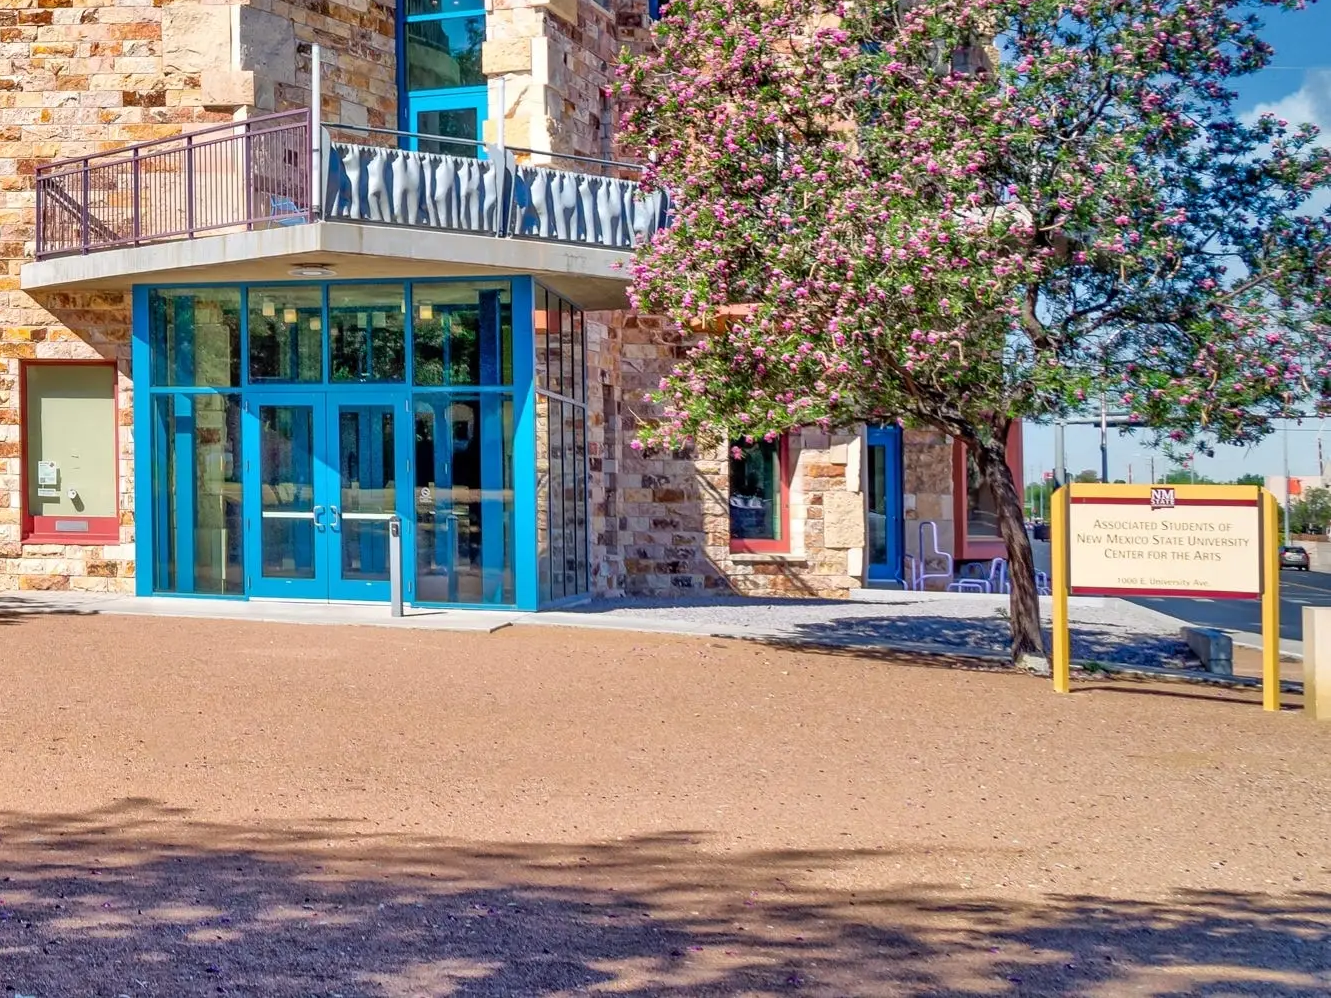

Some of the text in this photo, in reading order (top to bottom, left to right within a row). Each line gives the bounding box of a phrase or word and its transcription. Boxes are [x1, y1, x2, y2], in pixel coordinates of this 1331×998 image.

[1151, 489, 1175, 500] NM
[1093, 519, 1234, 532] ASSOCIATED STUDENTS OF
[1076, 533, 1250, 547] NEW MEXICO STATE UNIVERSITY
[1104, 548, 1222, 561] CENTER FOR THE ARTS
[1149, 578, 1190, 587] University
